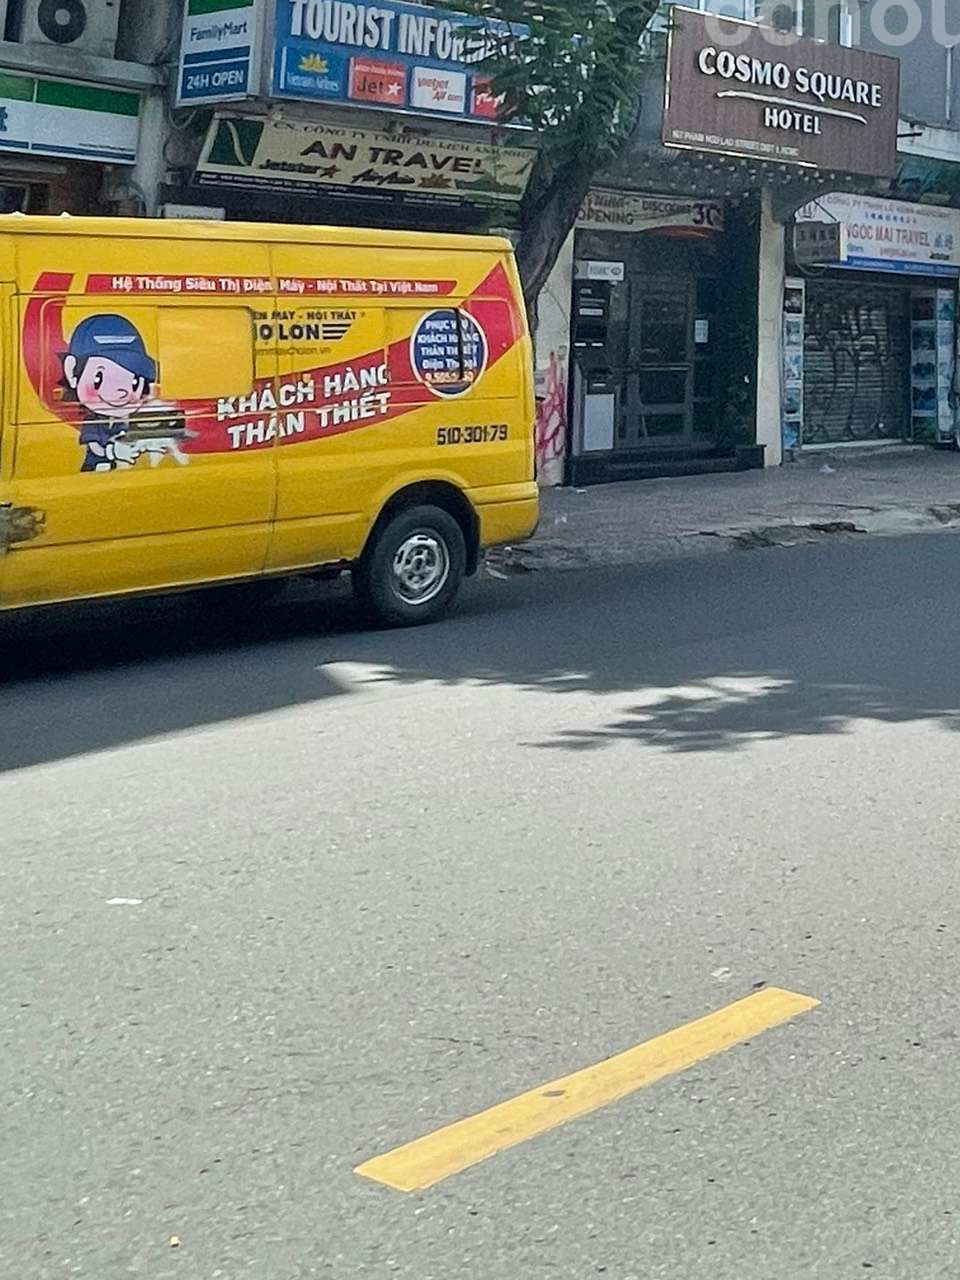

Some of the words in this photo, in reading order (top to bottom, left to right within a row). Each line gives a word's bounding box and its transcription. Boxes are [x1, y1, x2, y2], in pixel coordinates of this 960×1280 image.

[190, 22, 248, 42] FamilyMart
[187, 74, 209, 90] 24H
[211, 70, 244, 87] OPEN
[698, 47, 791, 89] COSMO
[795, 68, 882, 107] SQUARE
[764, 107, 822, 135] HOTEL
[300, 140, 357, 162] AN
[369, 146, 485, 175] TRAVEL
[578, 207, 634, 225] OPENING
[896, 228, 930, 247] TRAVEL
[216, 378, 315, 422] KHÁCH
[226, 411, 305, 449] THÂN
[316, 387, 392, 428] THIẾT
